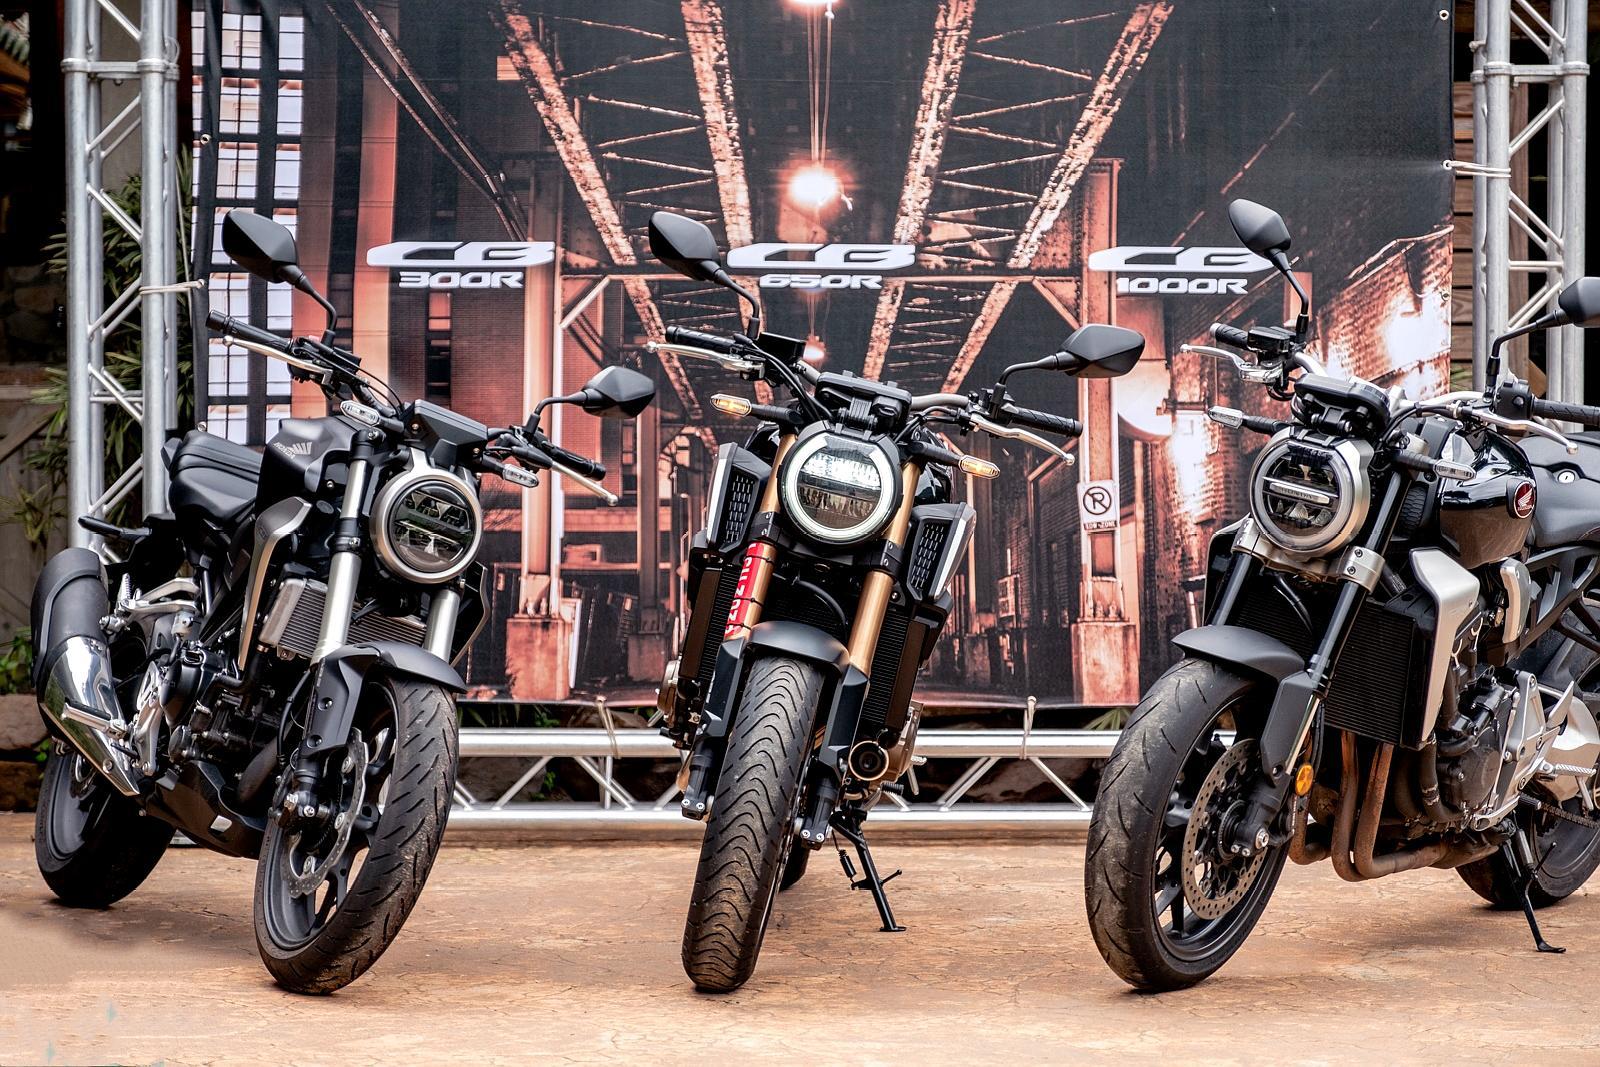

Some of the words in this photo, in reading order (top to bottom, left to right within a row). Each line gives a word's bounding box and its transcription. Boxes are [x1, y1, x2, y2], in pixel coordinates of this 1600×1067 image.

[367, 241, 555, 267] CB
[727, 243, 915, 270] CB
[1088, 246, 1275, 272] CB
[398, 271, 524, 289] 300R
[759, 274, 883, 289] 650R
[1116, 277, 1248, 294] 1000R
